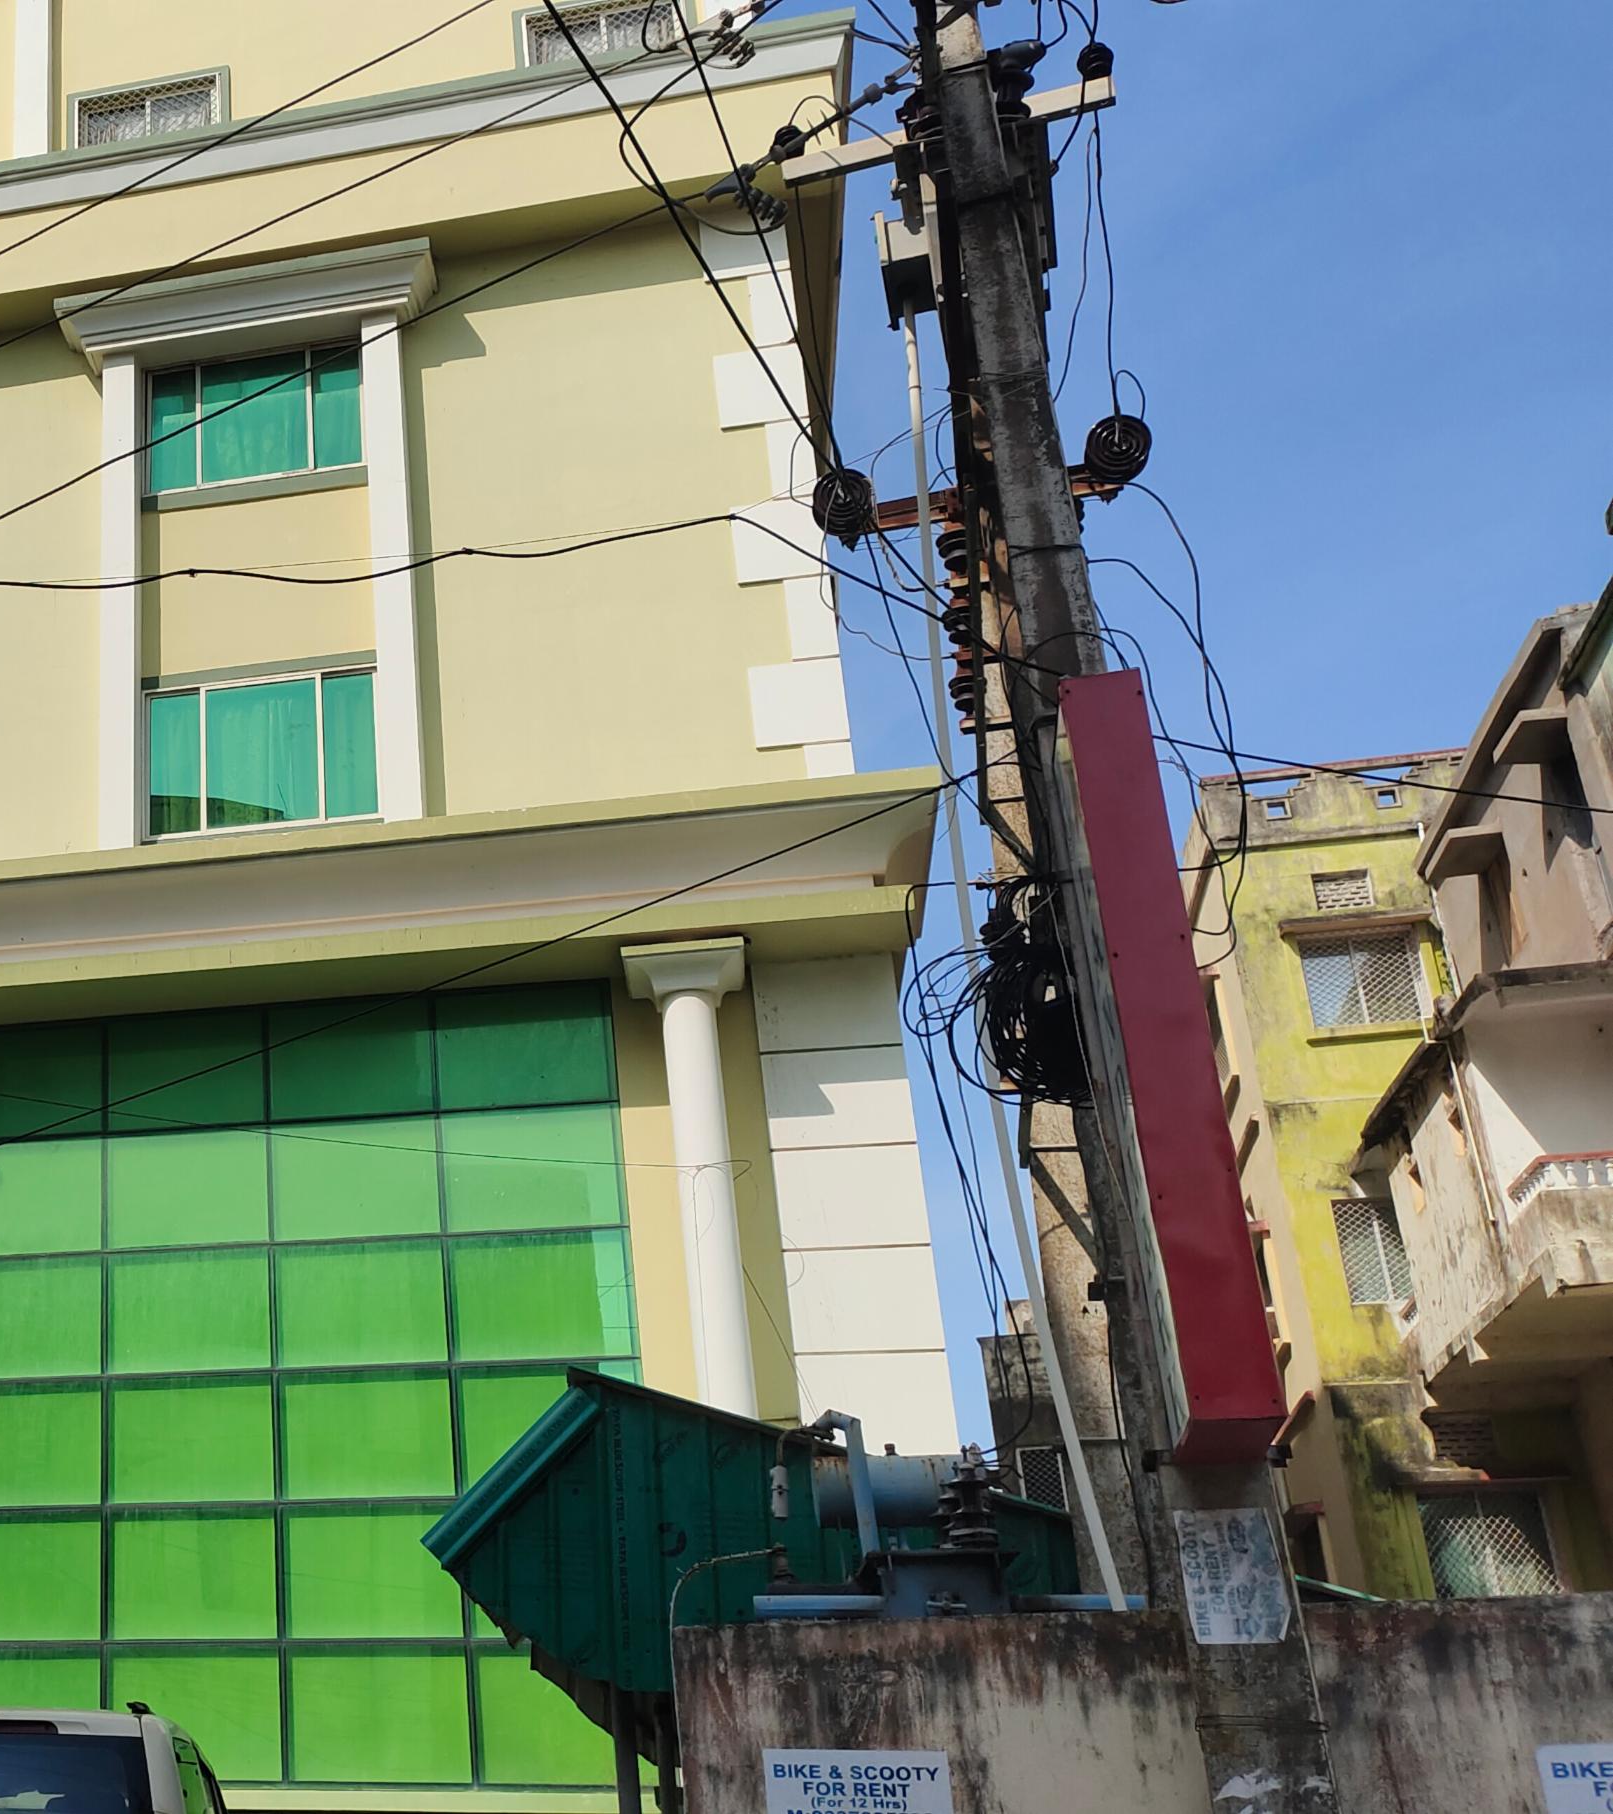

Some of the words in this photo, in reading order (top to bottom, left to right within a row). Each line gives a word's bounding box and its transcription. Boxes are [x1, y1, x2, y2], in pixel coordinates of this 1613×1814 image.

[1203, 1540, 1221, 1580] RENT
[1208, 1584, 1226, 1615] FOR
[1195, 1600, 1212, 1636] BIKE
[773, 1764, 821, 1778] BIKE
[829, 1765, 843, 1779] &
[850, 1766, 939, 1782] SCOOTY
[1551, 1761, 1613, 1778] BIKE
[803, 1782, 847, 1797] FOR
[853, 1783, 910, 1798] RENT
[1593, 1781, 1613, 1797] F
[811, 1796, 844, 1809] (For
[849, 1797, 868, 1809] 12
[873, 1798, 907, 1812] Hrs)
